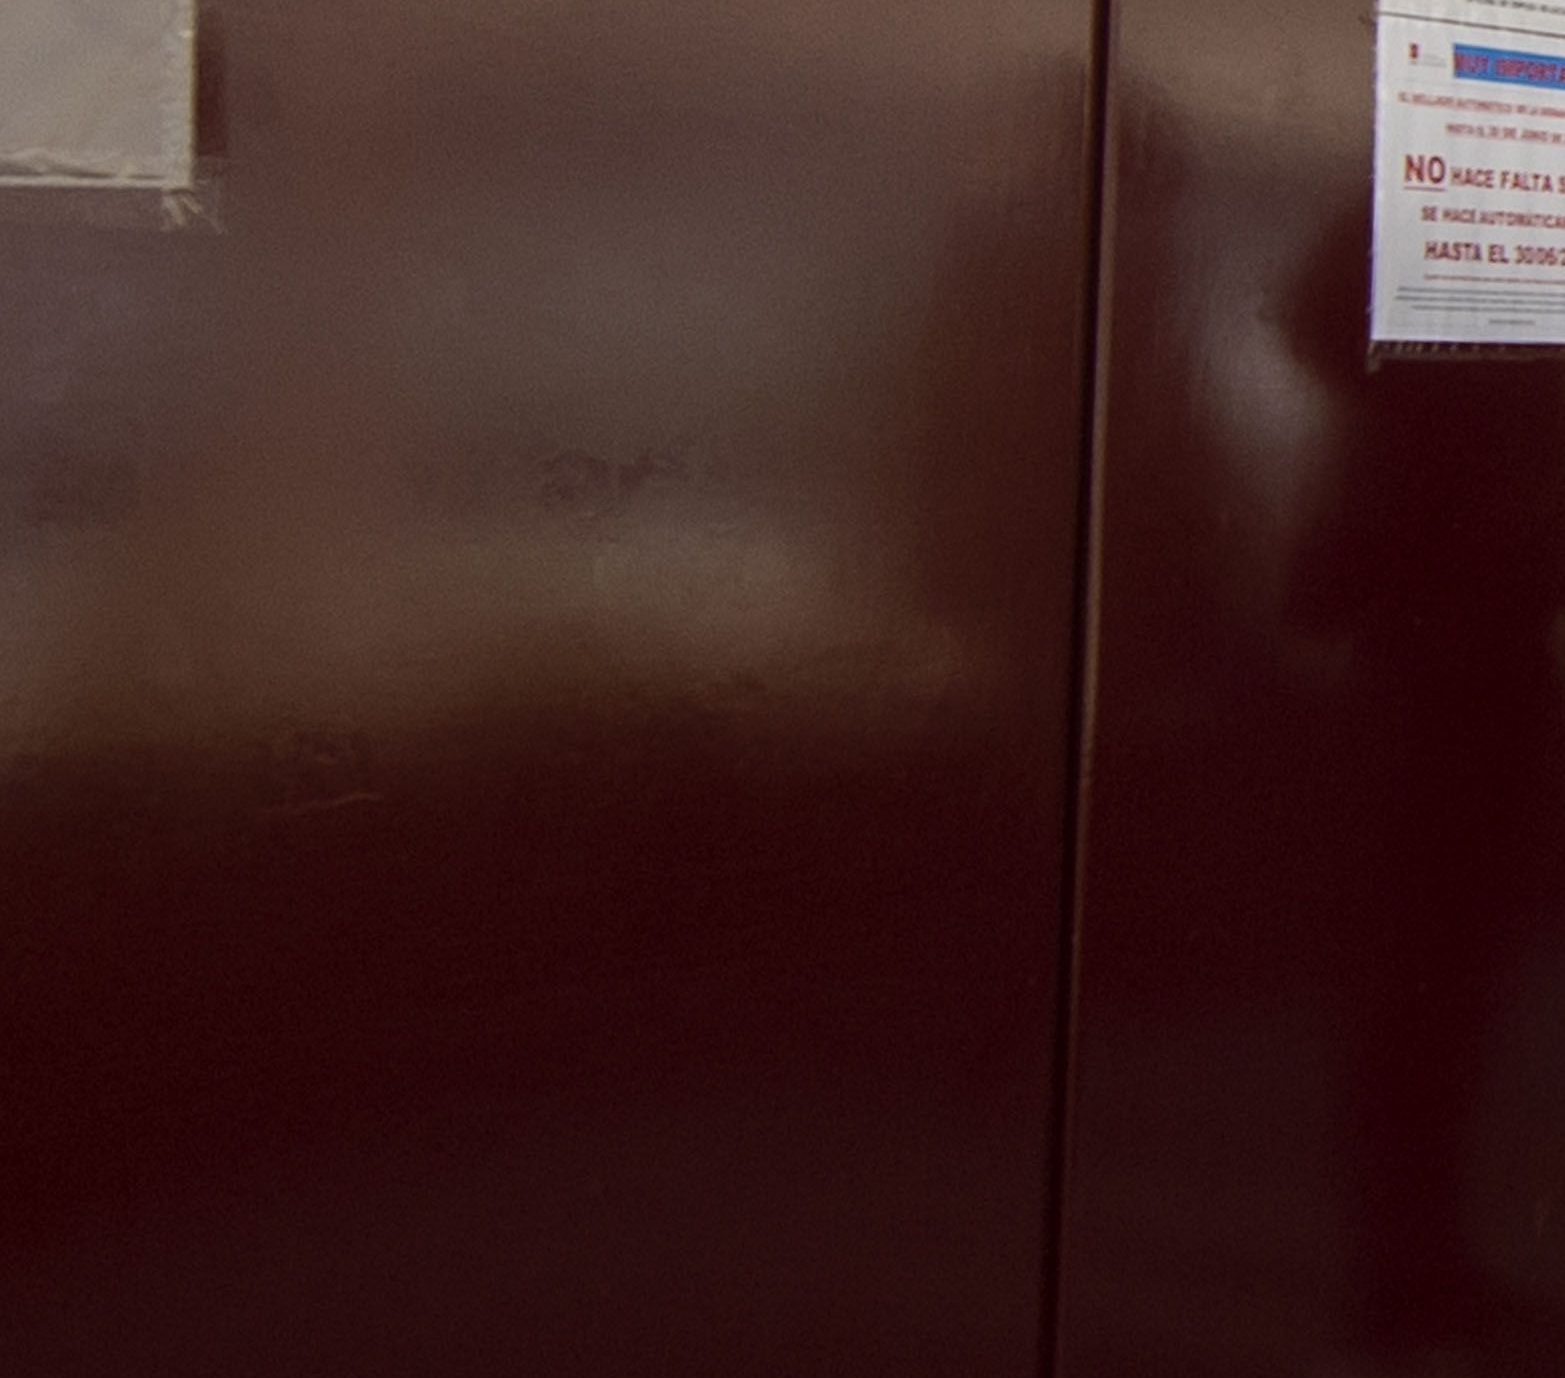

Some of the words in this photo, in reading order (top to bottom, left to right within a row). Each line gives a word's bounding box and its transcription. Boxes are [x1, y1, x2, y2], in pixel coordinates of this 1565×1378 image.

[1404, 154, 1446, 183] NO
[1451, 167, 1494, 188] HACE
[1500, 171, 1553, 192] FALTA
[1421, 206, 1437, 221] SE
[1443, 208, 1476, 223] HACE
[1424, 241, 1483, 262] HASTA
[1488, 243, 1509, 263] EL
